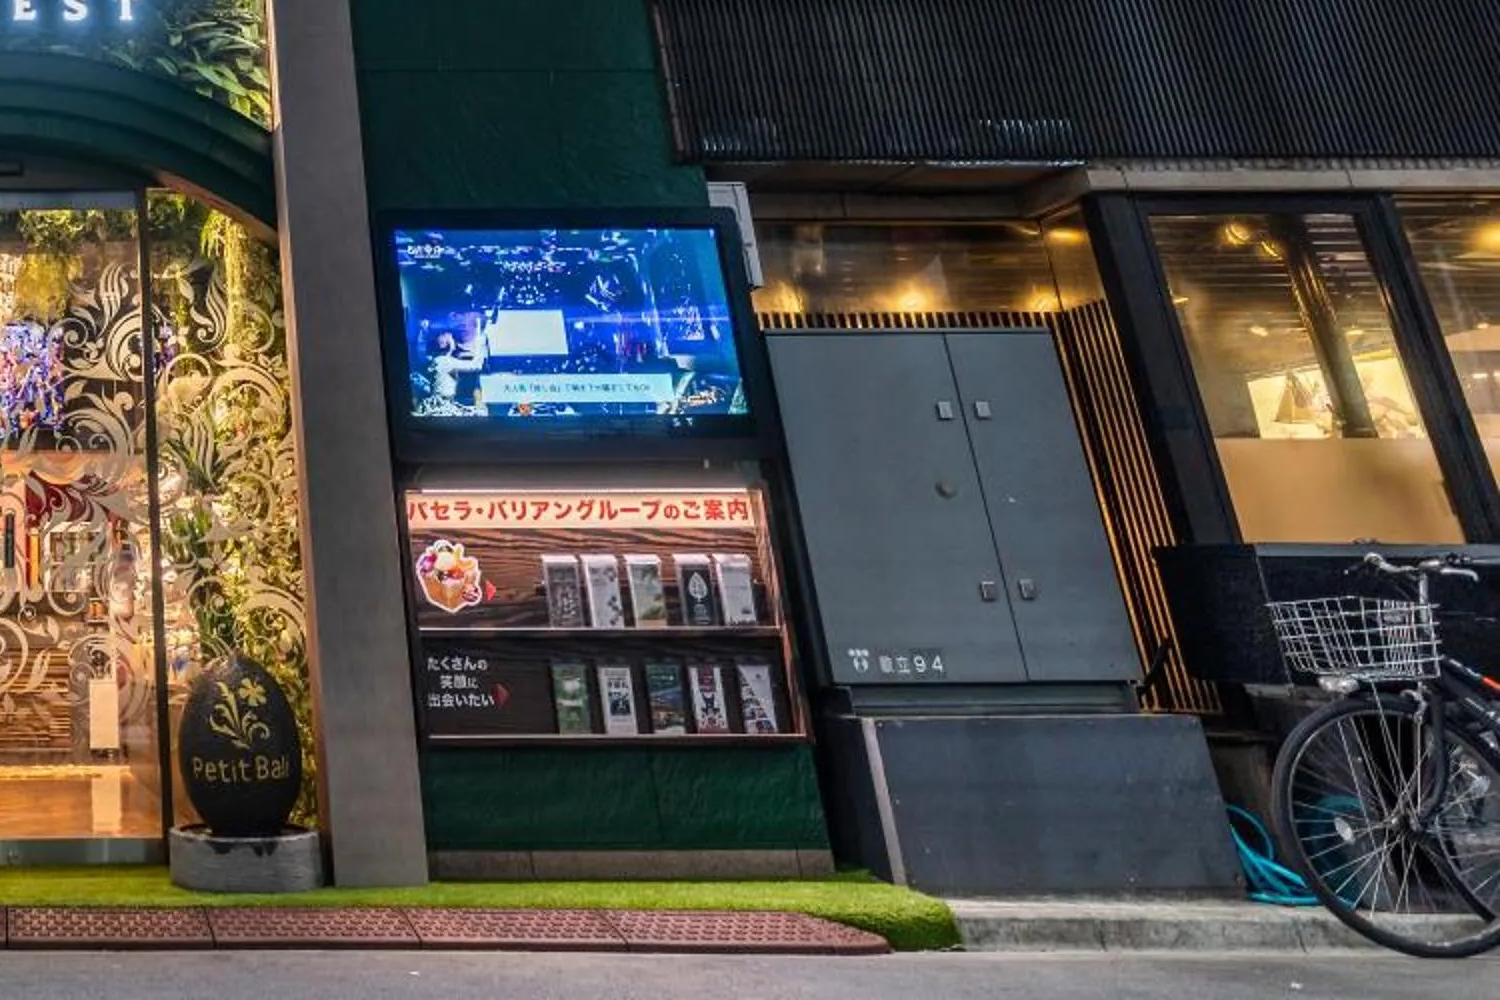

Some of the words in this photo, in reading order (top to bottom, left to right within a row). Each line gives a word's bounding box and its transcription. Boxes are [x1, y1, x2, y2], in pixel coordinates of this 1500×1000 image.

[427, 656, 489, 671] たくさんの
[192, 756, 250, 783] Petit
[254, 755, 290, 780] Bali
